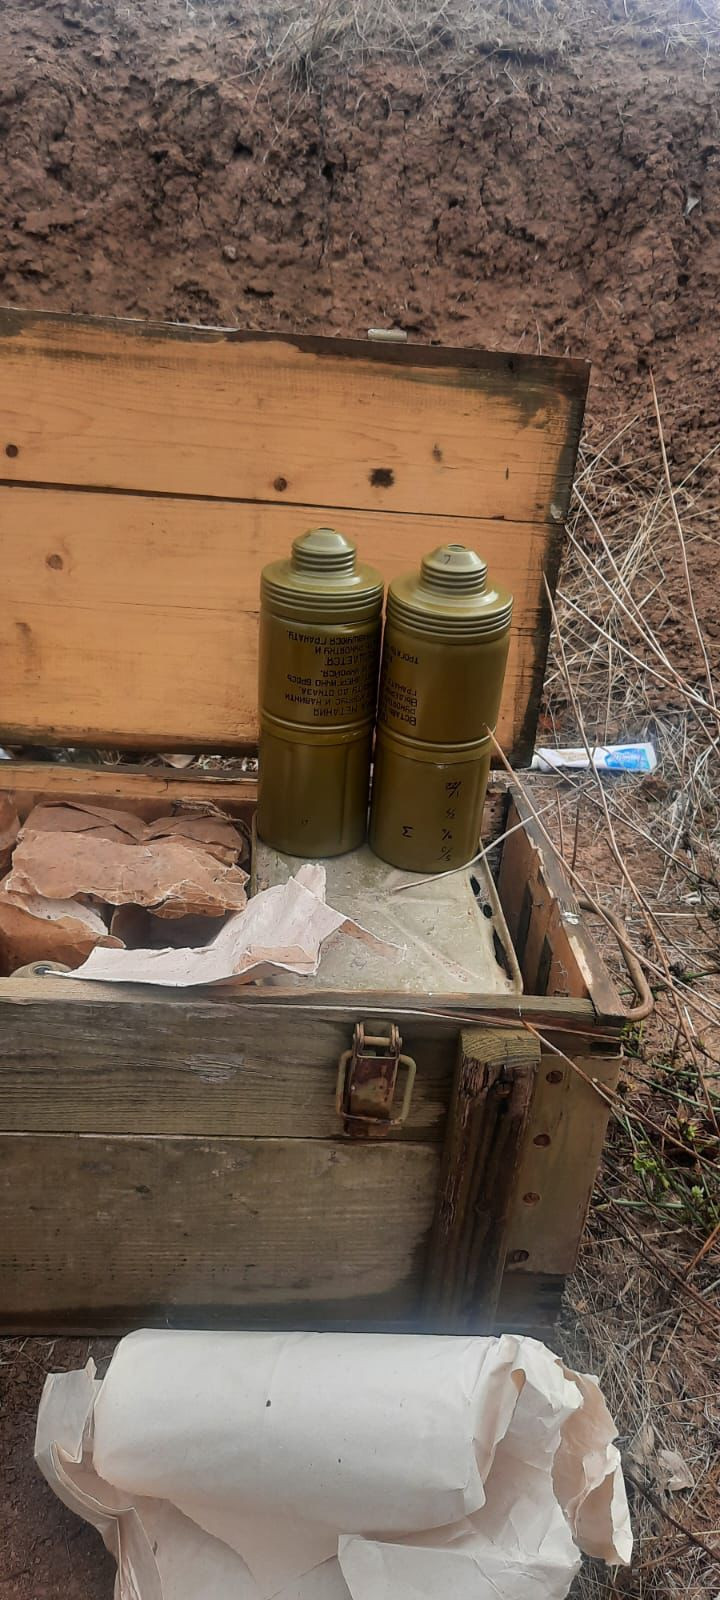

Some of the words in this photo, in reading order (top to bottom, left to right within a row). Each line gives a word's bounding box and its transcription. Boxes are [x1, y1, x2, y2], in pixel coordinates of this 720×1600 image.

[287, 630, 327, 645] ГРАНАТУ.
[287, 674, 312, 686] БРОСЬ
[337, 688, 349, 696] ДО
[285, 694, 322, 705] НАВИНТИ
